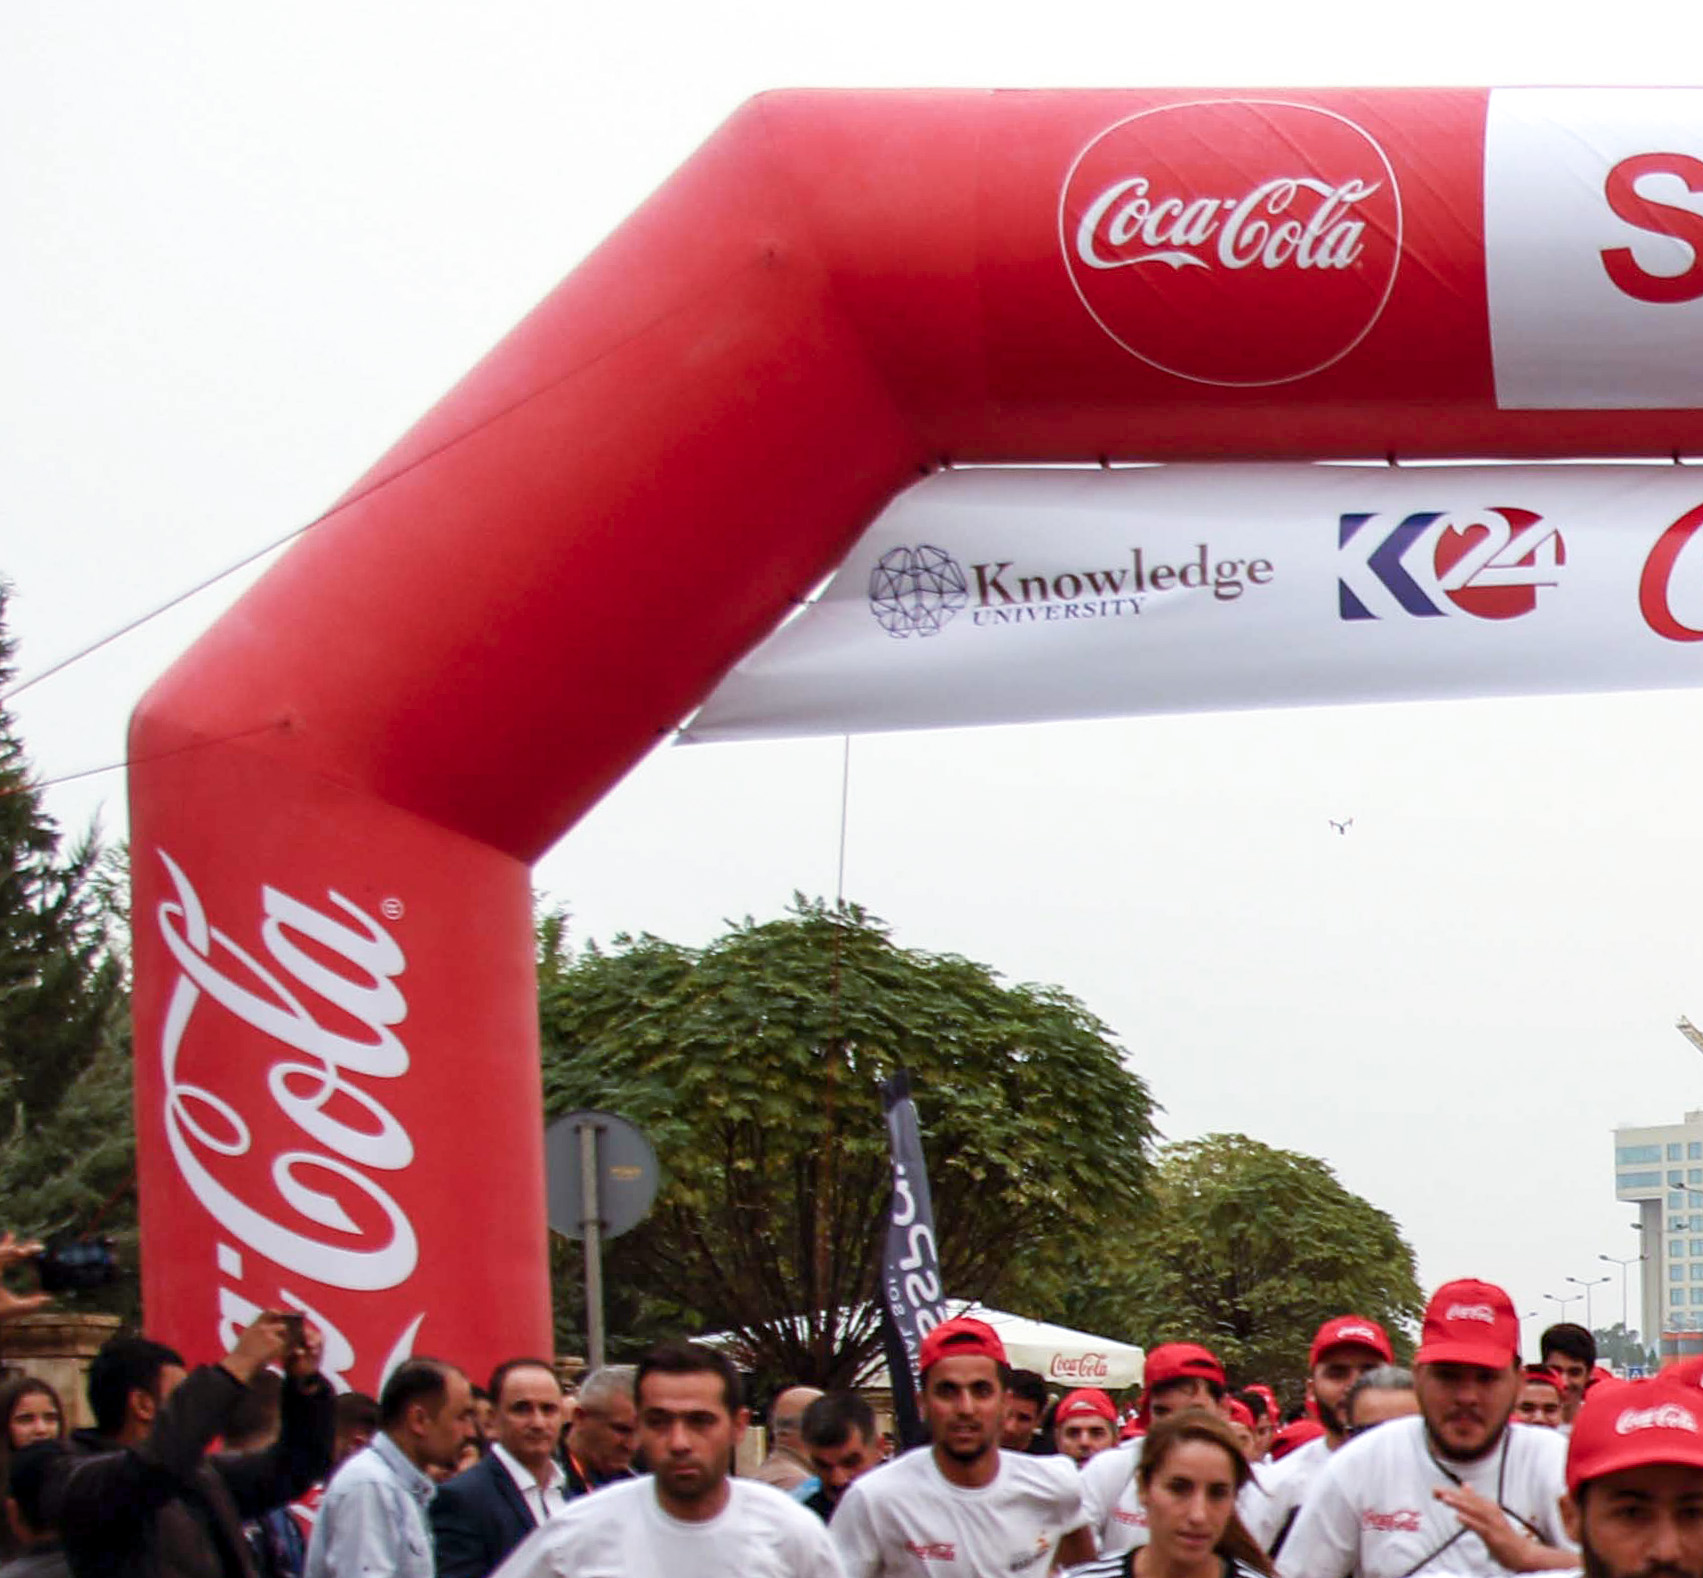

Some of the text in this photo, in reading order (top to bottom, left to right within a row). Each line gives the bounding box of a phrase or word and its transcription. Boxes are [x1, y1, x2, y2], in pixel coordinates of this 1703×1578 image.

[1077, 178, 1381, 269] Coca-Cola
[971, 545, 1274, 611] Knowledge
[973, 596, 1146, 627] UNIVERSITY
